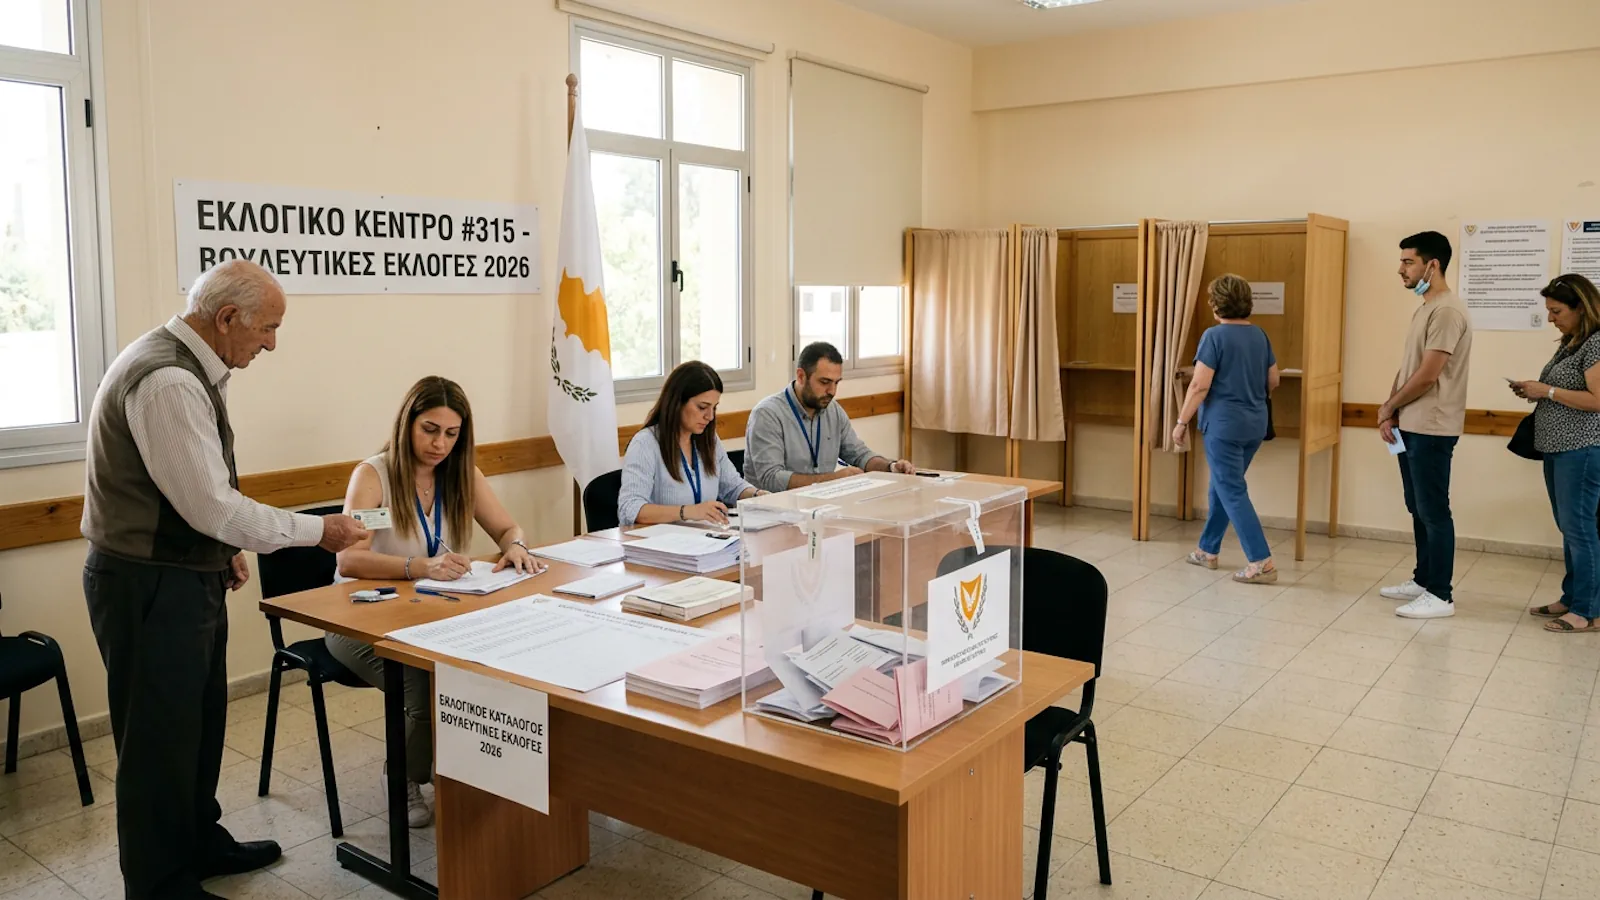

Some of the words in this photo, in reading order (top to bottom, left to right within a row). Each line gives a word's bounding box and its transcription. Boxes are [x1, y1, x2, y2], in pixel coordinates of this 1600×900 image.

[197, 199, 345, 237] ΕΚΛΟΓΙΚΟ
[355, 209, 453, 241] ΚΕΝΤΡΟ
[461, 215, 515, 244] #315
[384, 252, 478, 277] ΕΚΛΟΓΕΣ
[484, 255, 530, 279] 2026
[479, 741, 503, 759] 2026
